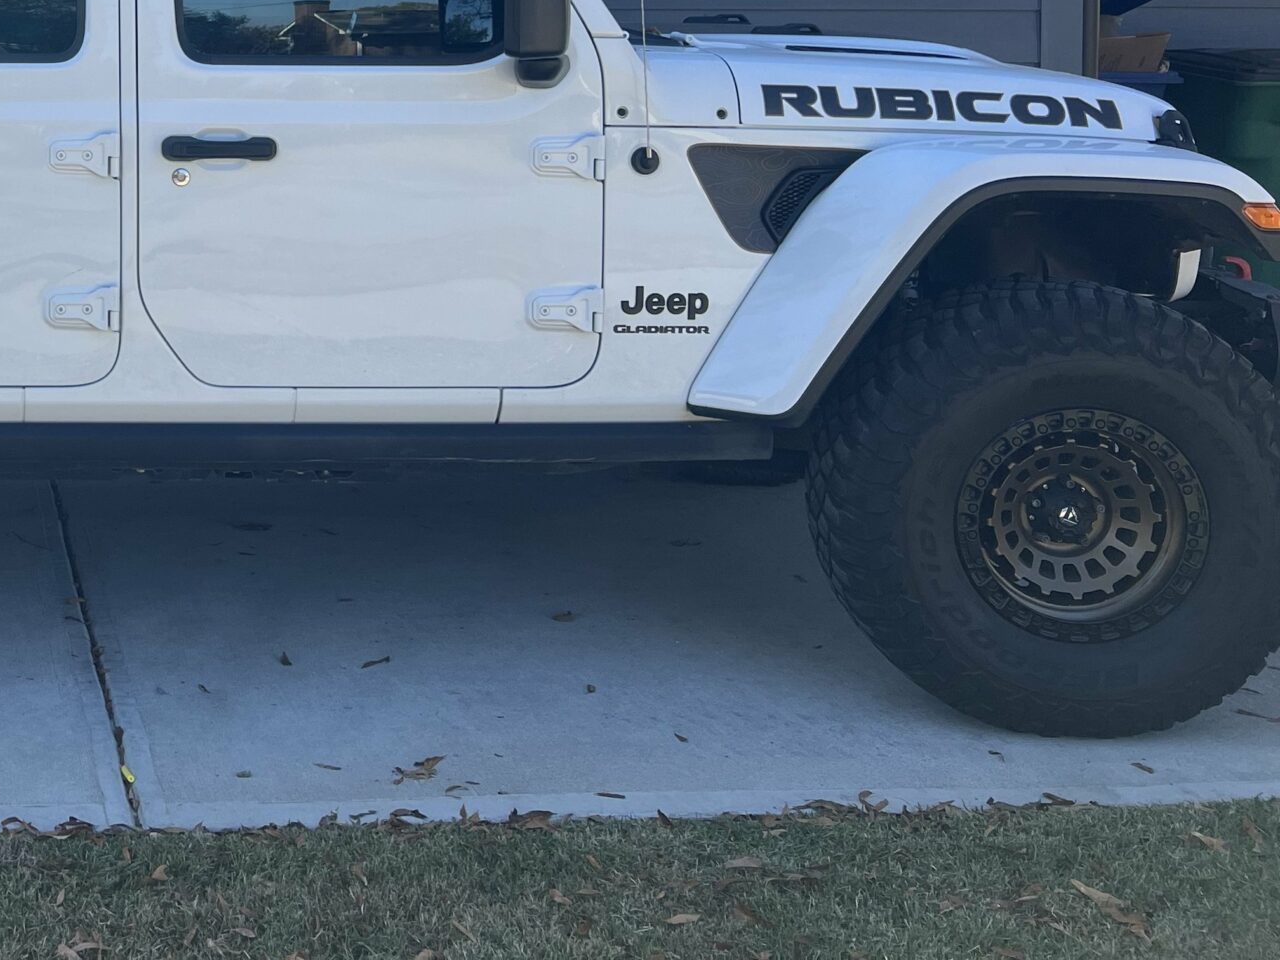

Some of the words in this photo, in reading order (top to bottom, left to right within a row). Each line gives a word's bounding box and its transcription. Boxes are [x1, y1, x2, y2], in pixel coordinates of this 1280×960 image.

[760, 84, 1123, 129] RUBICON
[621, 286, 709, 320] Jeep
[613, 324, 710, 334] GLADIATOR
